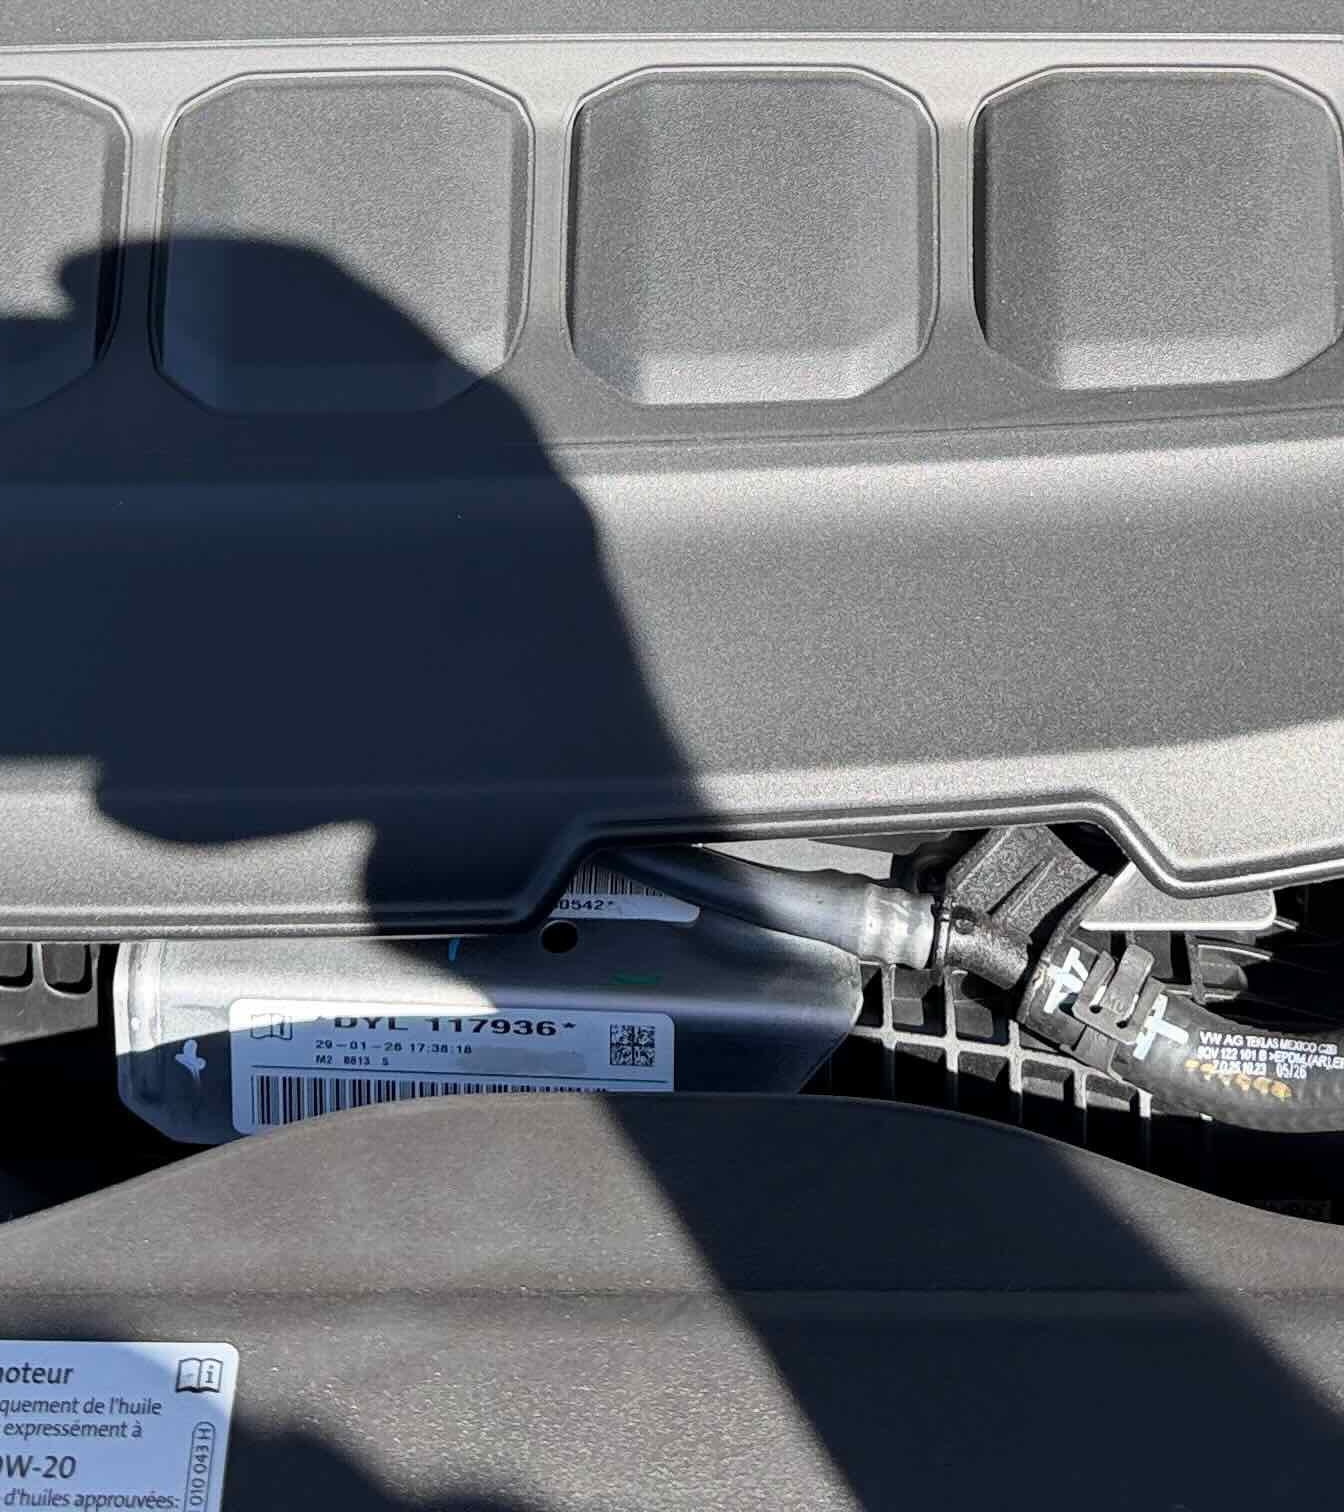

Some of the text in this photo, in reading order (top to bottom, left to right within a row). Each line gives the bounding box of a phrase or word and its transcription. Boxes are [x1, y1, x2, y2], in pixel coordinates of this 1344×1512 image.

[1199, 1031, 1223, 1045] VW
[1225, 1034, 1243, 1046] AG
[83, 1398, 105, 1414] de
[109, 1398, 162, 1415] l'huile
[3, 1421, 127, 1440] expressément
[130, 1421, 142, 1438] à
[197, 1427, 212, 1440] H
[193, 1444, 210, 1474] 043
[4, 1490, 70, 1508] d'huiles
[74, 1492, 180, 1512] approuvées:
